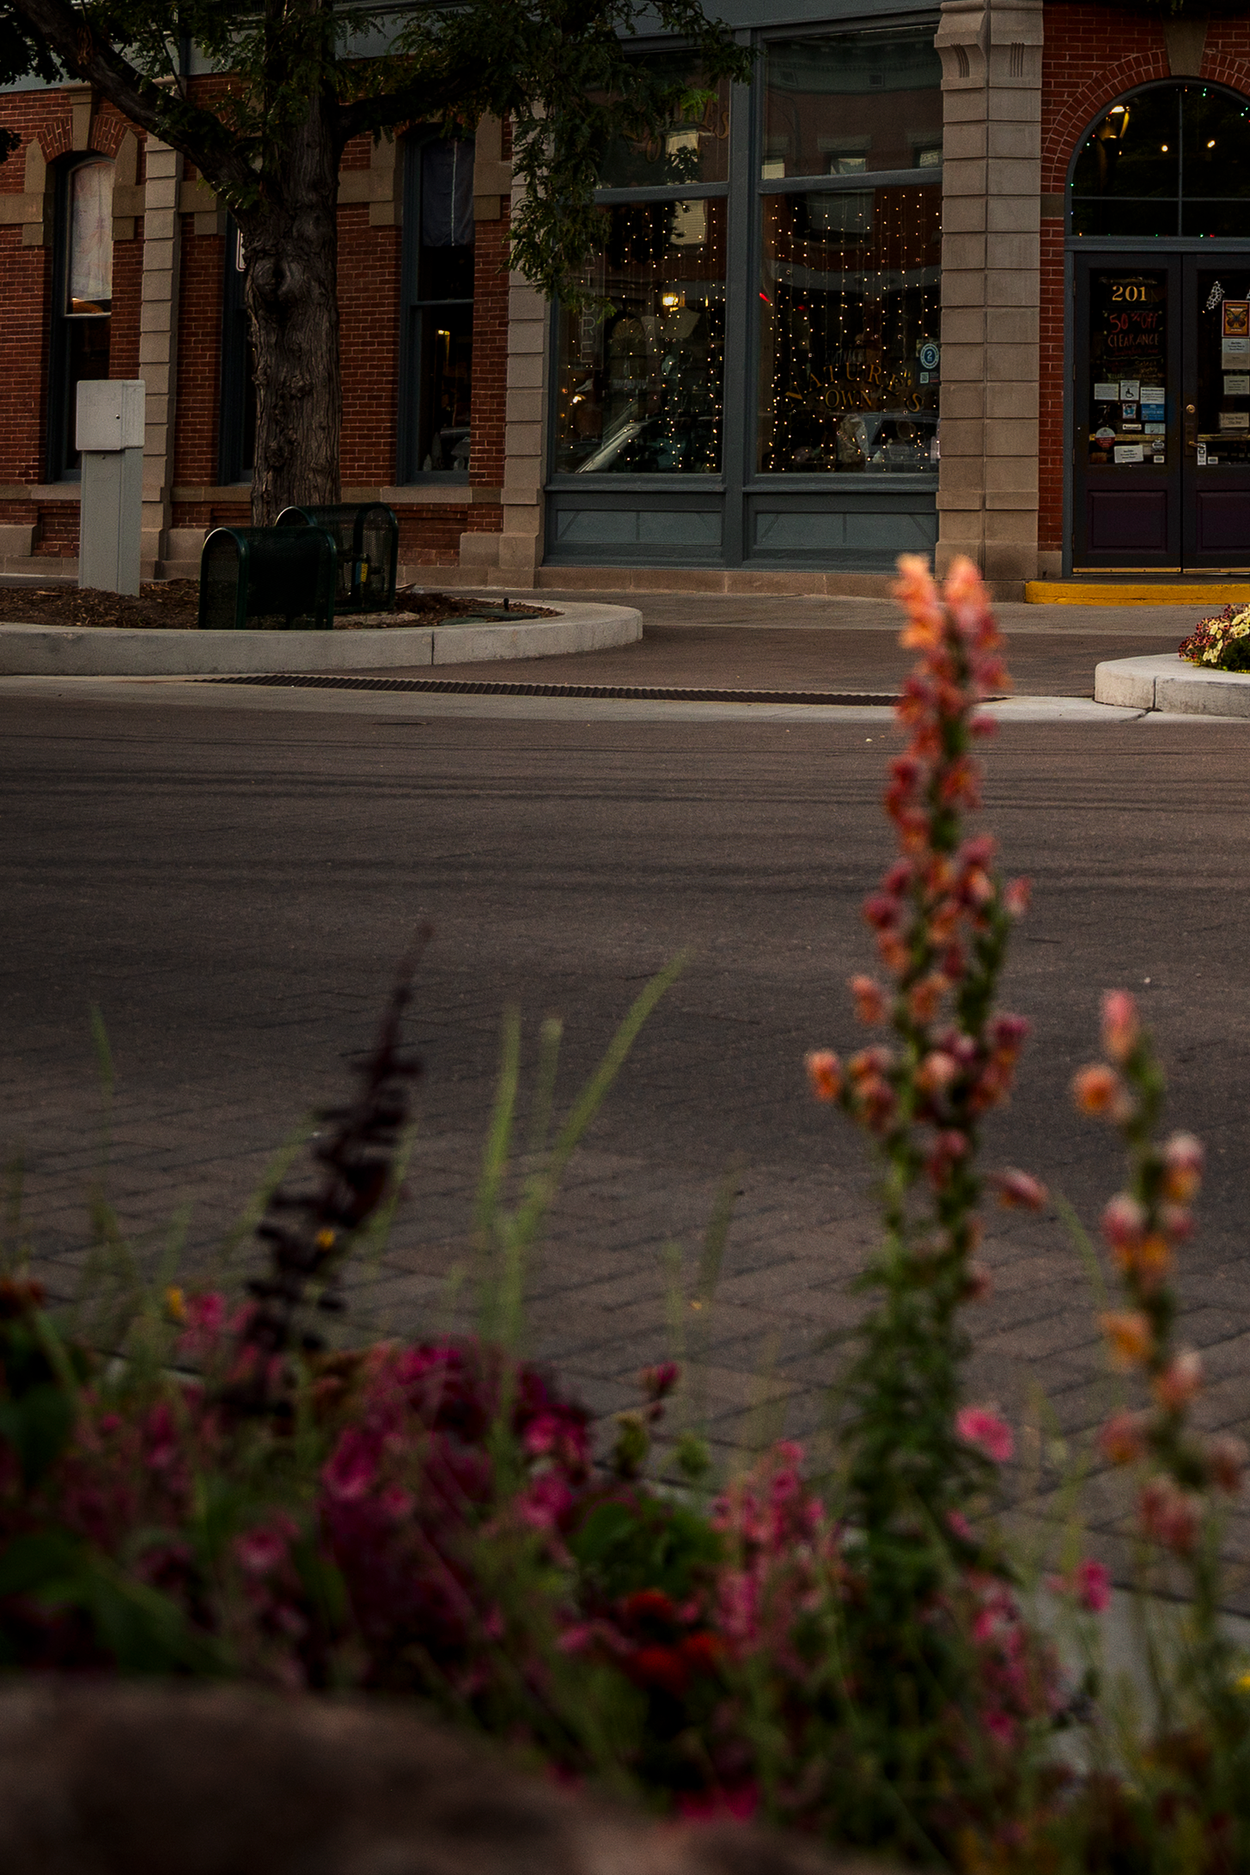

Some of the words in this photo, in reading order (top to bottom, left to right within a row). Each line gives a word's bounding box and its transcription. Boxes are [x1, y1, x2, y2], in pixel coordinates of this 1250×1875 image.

[1111, 285, 1148, 302] 201
[1107, 333, 1159, 347] CLEARANCE
[825, 389, 873, 409] OWN
